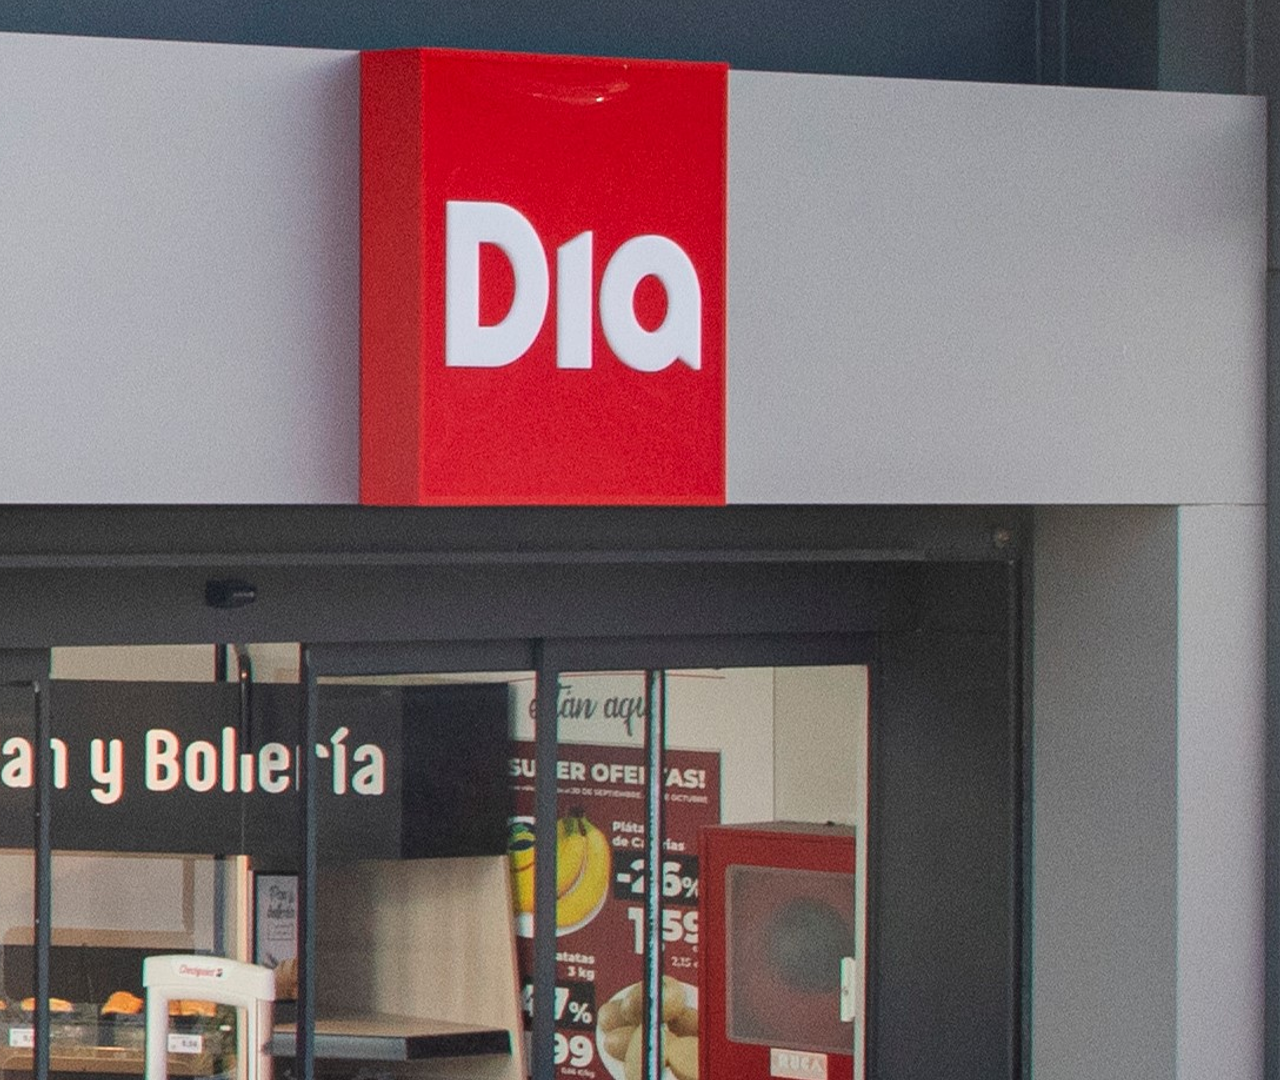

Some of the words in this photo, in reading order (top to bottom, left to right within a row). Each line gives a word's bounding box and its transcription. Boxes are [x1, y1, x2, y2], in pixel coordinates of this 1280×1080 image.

[90, 738, 124, 804] y
[509, 758, 585, 781] SUER
[556, 952, 595, 965] atatas
